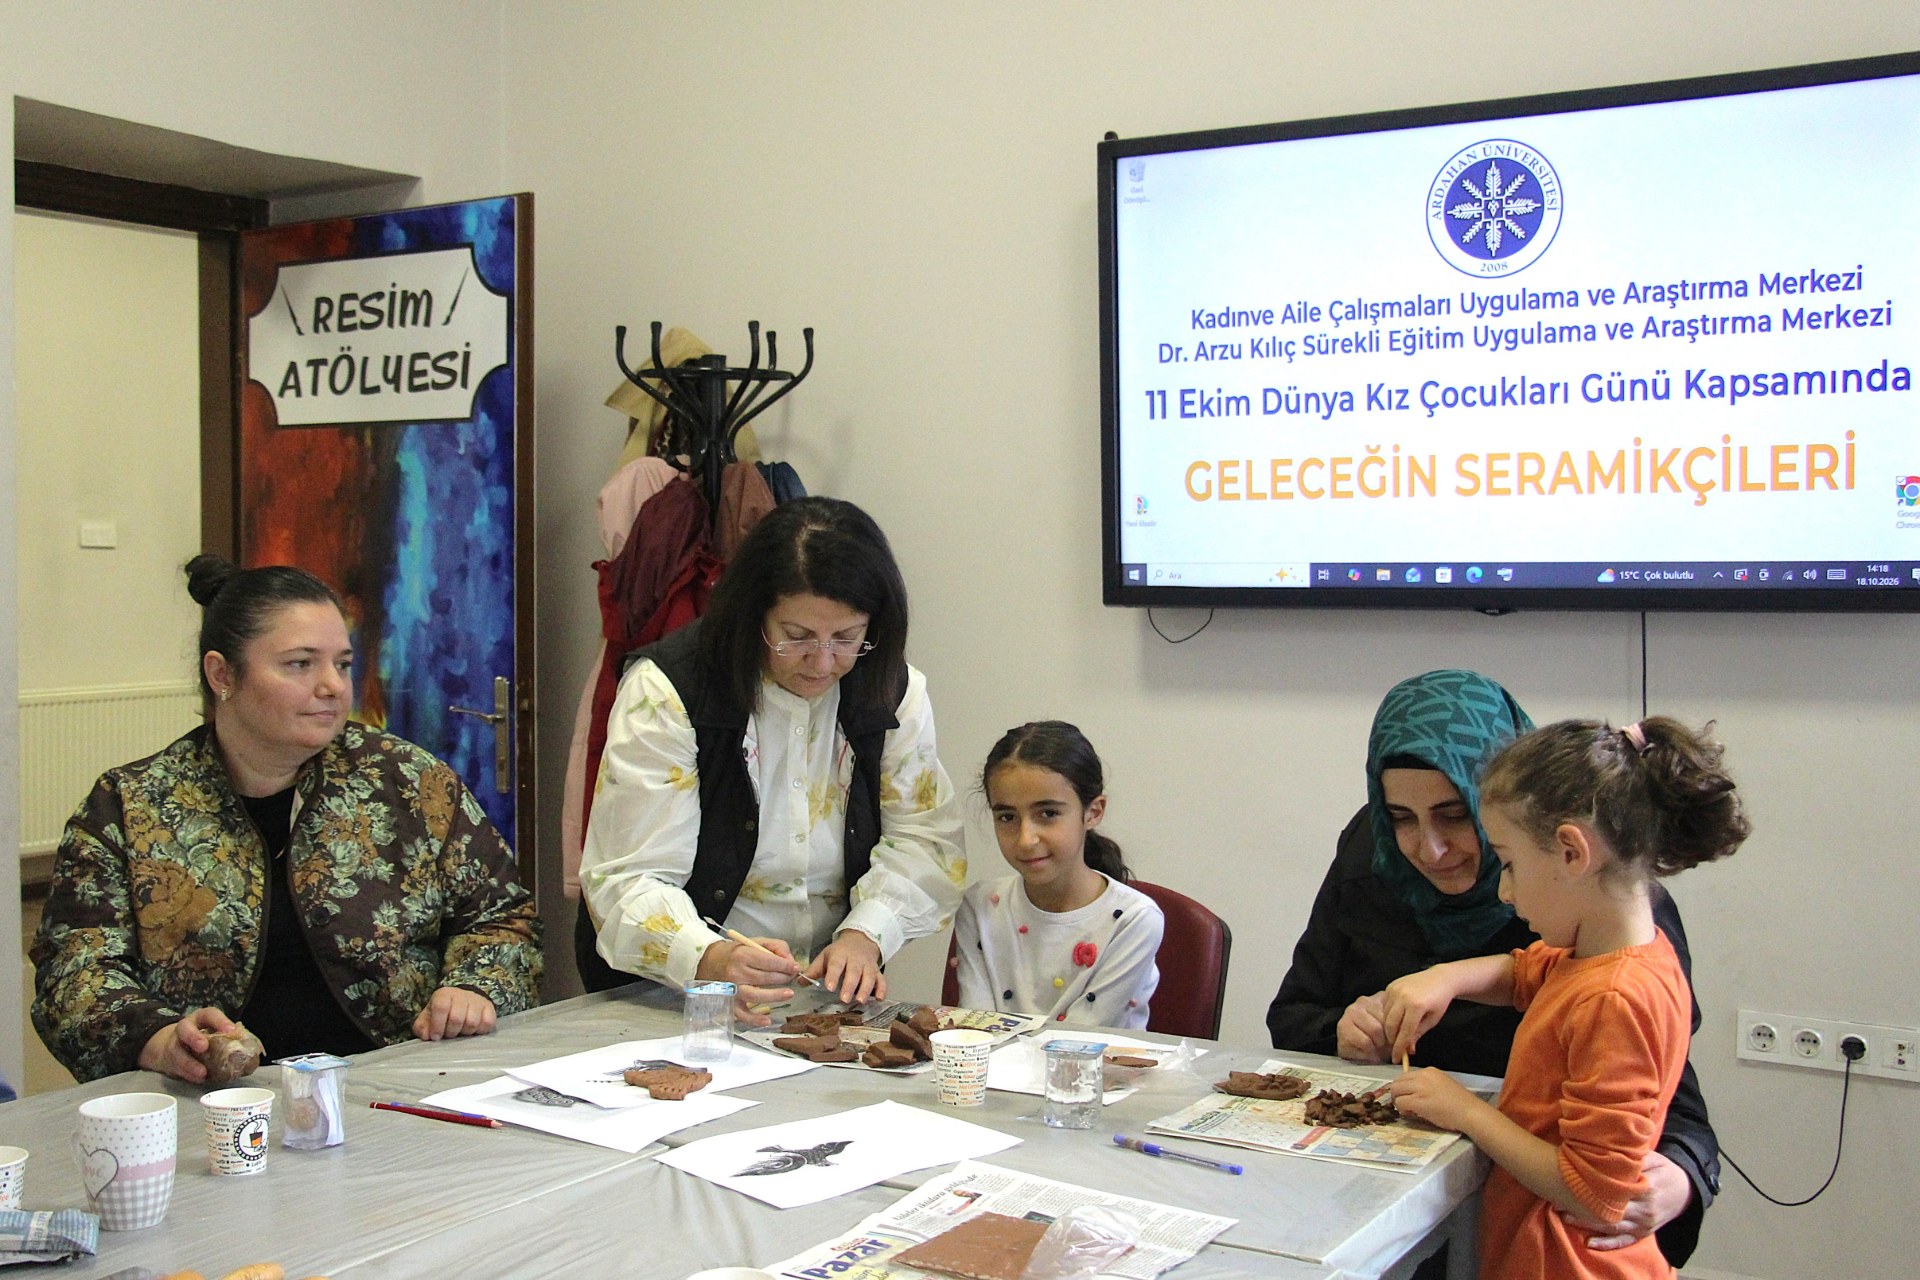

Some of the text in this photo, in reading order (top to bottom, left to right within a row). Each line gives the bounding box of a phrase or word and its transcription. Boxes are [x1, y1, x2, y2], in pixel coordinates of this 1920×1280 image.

[1432, 143, 1560, 220] ARDAHAN ÜNİVERSİTESİ
[1480, 261, 1508, 273] 2008
[313, 282, 433, 334] RESİM
[1191, 264, 1863, 330] Kadınve Aile Çalışmaları Uygulama ve Araştırma Merkezi
[1158, 300, 1892, 364] Dr. Arzu Kılıç Sürekli Eğitim Uygulama ve Araştırma Merkezi
[278, 342, 471, 398] ATÖLYESİ
[1145, 359, 1911, 421] 11 Ekim Dünya Kız Çocukları Günü Kapsamında
[1184, 429, 1856, 506] GELECEĞİN SERAMİKÇİLERİ
[1168, 572, 1182, 580] Ara
[1644, 570, 1661, 581] Çok
[1663, 570, 1694, 580] bulutlu
[1866, 564, 1889, 572] 14:18
